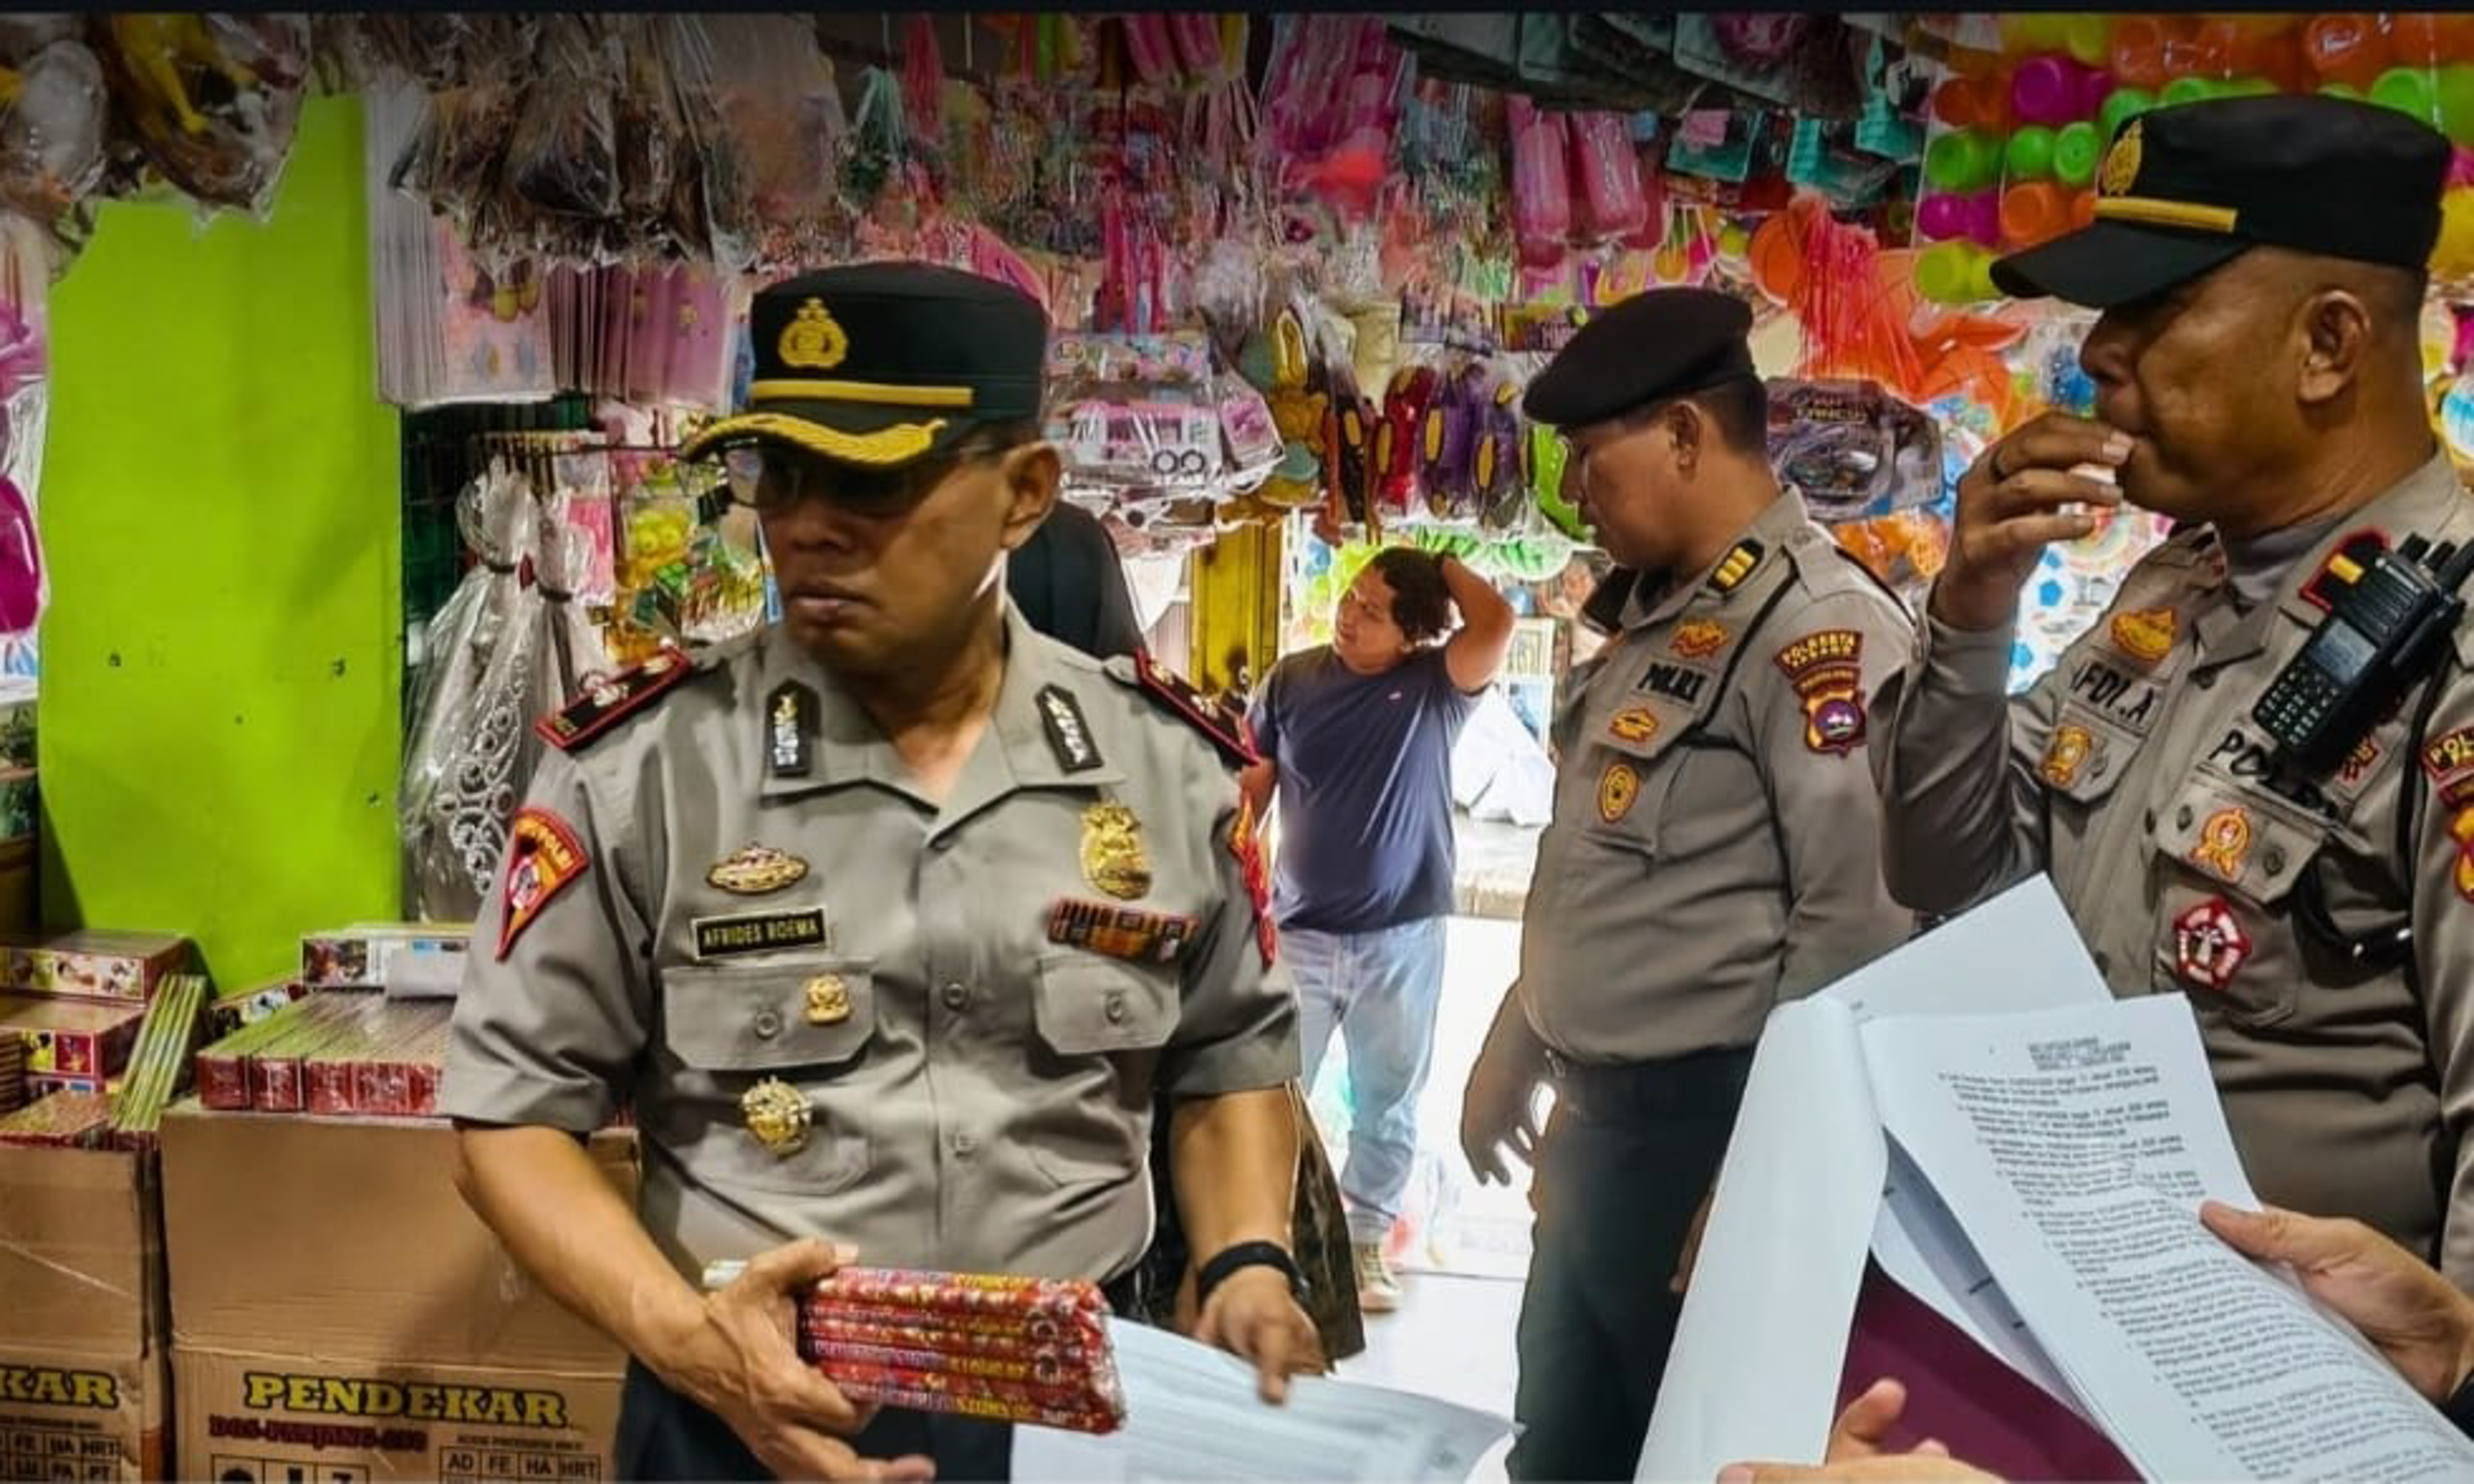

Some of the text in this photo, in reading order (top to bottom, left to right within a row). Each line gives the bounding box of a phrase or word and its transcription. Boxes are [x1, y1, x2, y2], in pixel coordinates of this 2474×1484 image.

[1637, 661, 1708, 705] POLRI
[244, 1371, 568, 1428] PENDEKAR
[447, 1454, 474, 1471] AD
[489, 1456, 511, 1473] FE
[526, 1457, 551, 1475] HA
